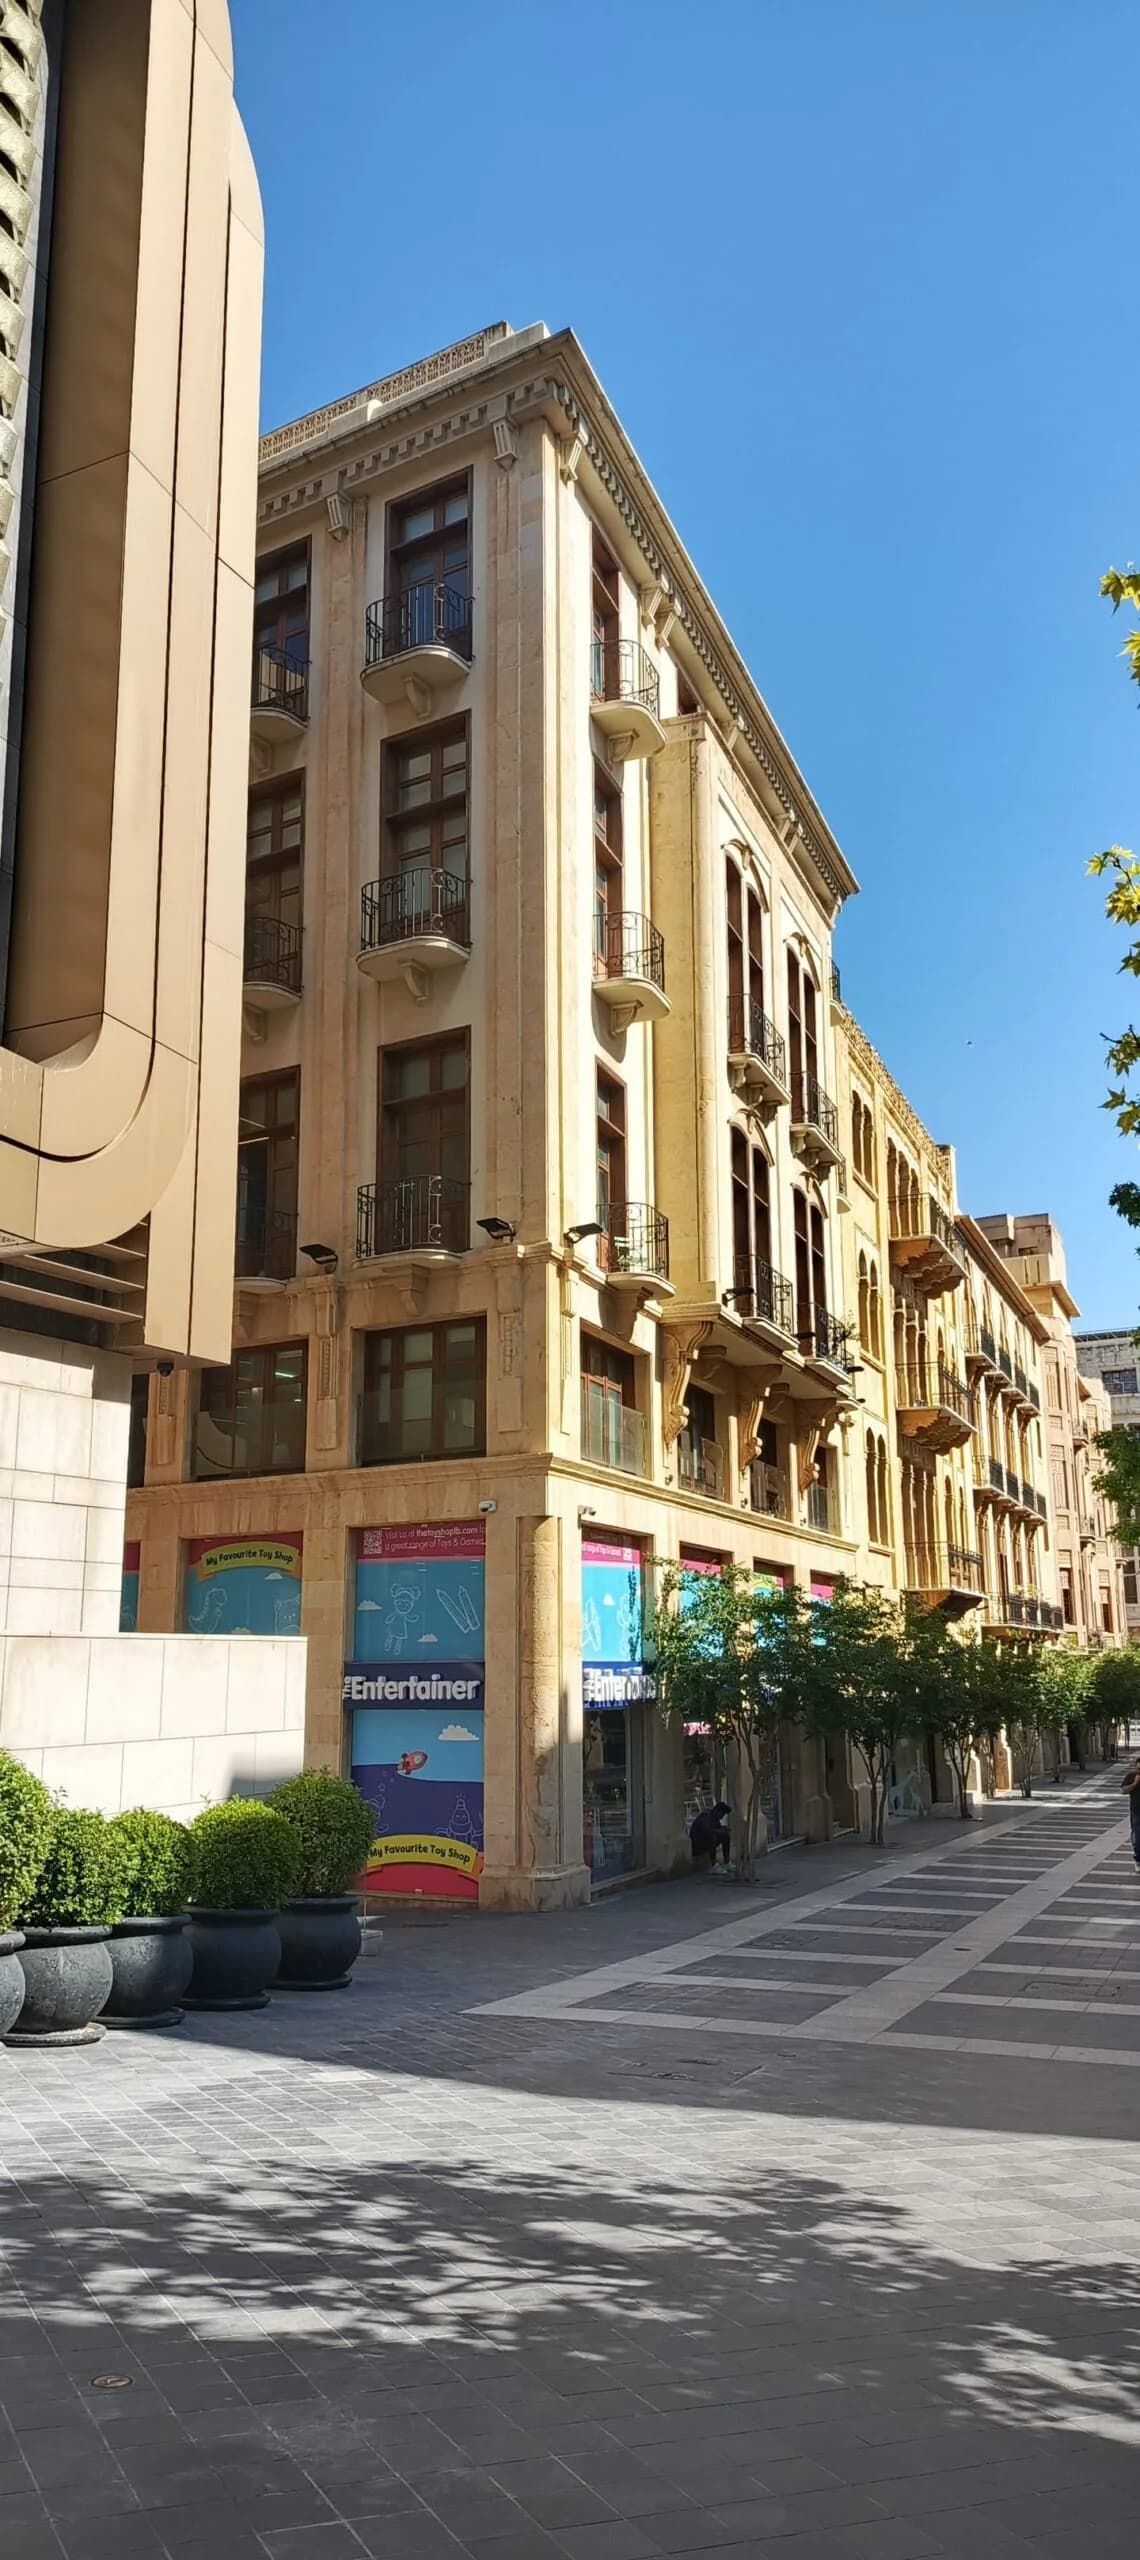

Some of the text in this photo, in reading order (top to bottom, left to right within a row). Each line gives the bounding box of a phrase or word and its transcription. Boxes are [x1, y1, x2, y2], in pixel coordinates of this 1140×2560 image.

[437, 1538, 452, 1549] Toys
[206, 1549, 293, 1566] My Favourite Toy Shop
[341, 1674, 480, 1700] The Entertainer
[370, 1844, 470, 1864] My Favourite Toy Shop
